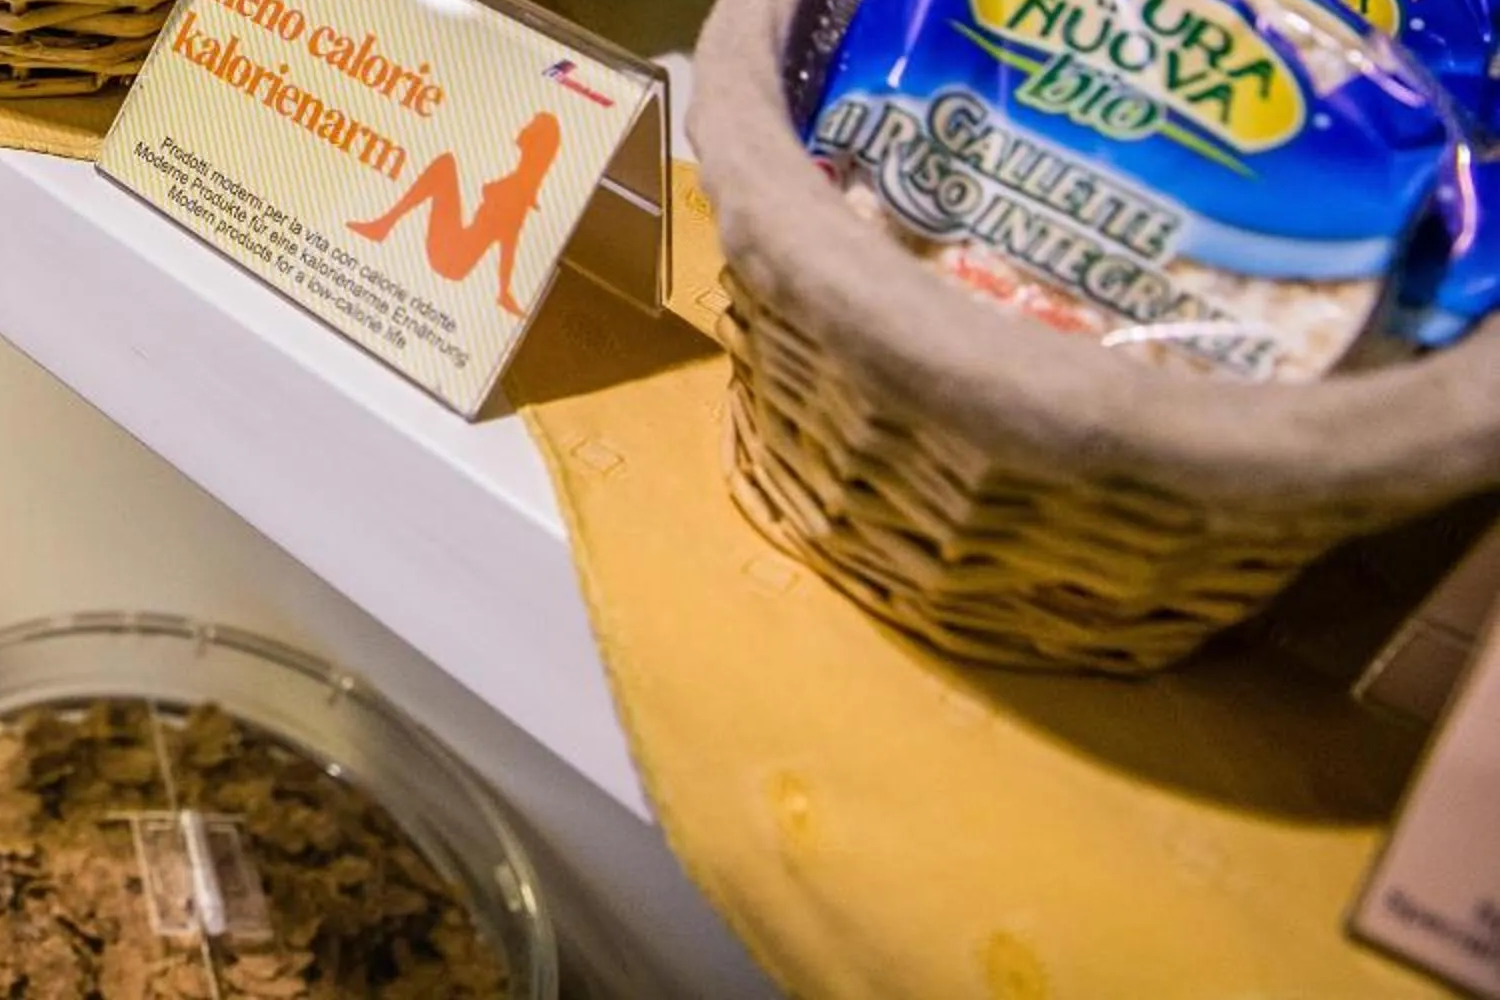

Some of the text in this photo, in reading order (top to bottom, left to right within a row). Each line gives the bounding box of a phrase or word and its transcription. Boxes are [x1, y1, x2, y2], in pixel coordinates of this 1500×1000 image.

[172, 11, 407, 182] kalorienarm
[307, 25, 445, 118] calorie
[1018, 52, 1164, 138] bio
[133, 141, 190, 185] Moderne
[190, 177, 247, 223] Produkte
[249, 214, 269, 234] für
[269, 231, 299, 255] eine
[299, 248, 390, 313] kalorienarme
[160, 135, 213, 177] Prodotti
[262, 204, 289, 227] per
[288, 215, 303, 236] la
[303, 228, 330, 252] vita
[330, 246, 360, 272] con
[167, 184, 216, 225] Modern
[214, 219, 273, 263] products
[275, 255, 295, 275] for
[295, 271, 305, 284] a
[306, 278, 383, 334] low-calorie
